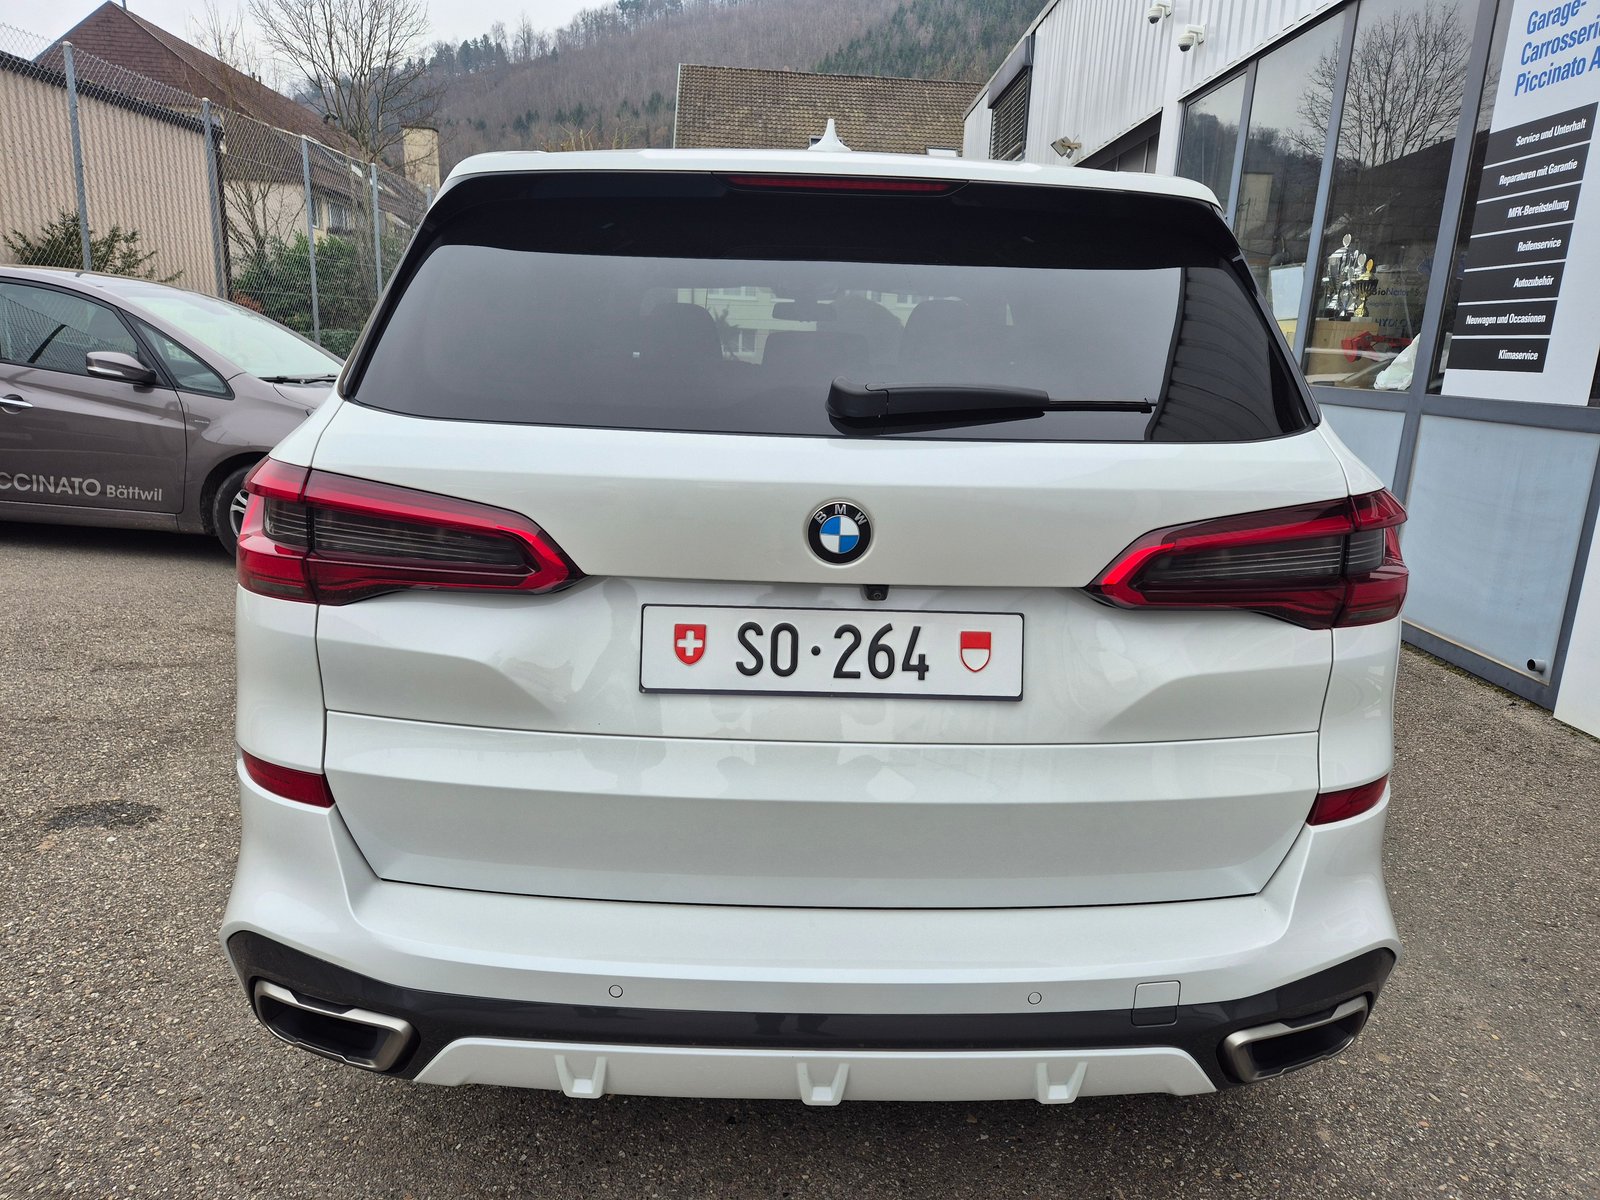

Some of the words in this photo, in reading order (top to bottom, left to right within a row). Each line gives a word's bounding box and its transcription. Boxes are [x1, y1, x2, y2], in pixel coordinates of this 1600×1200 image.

[1526, 0, 1587, 35] Garage-
[1520, 14, 1600, 66] Carrosseri
[1514, 56, 1587, 97] Piccinato
[1515, 132, 1540, 147] Service
[1540, 126, 1553, 140] und
[1553, 118, 1587, 136] Unterhalt
[1498, 169, 1537, 187] Reparaturen
[1536, 165, 1548, 177] mit
[1548, 158, 1578, 174] Garantie
[1507, 200, 1570, 219] MFK-Bereitstellung
[1517, 237, 1562, 252] Reifenservice
[1513, 275, 1555, 288] Autozubehör
[1465, 314, 1496, 326] Neuwagen
[1496, 313, 1509, 324] und
[1509, 313, 1547, 324] Occasionen
[1498, 349, 1539, 361] Klimaservice
[0, 472, 101, 496] CCINATO
[106, 484, 163, 502] Bättwil
[813, 503, 868, 526] BMW
